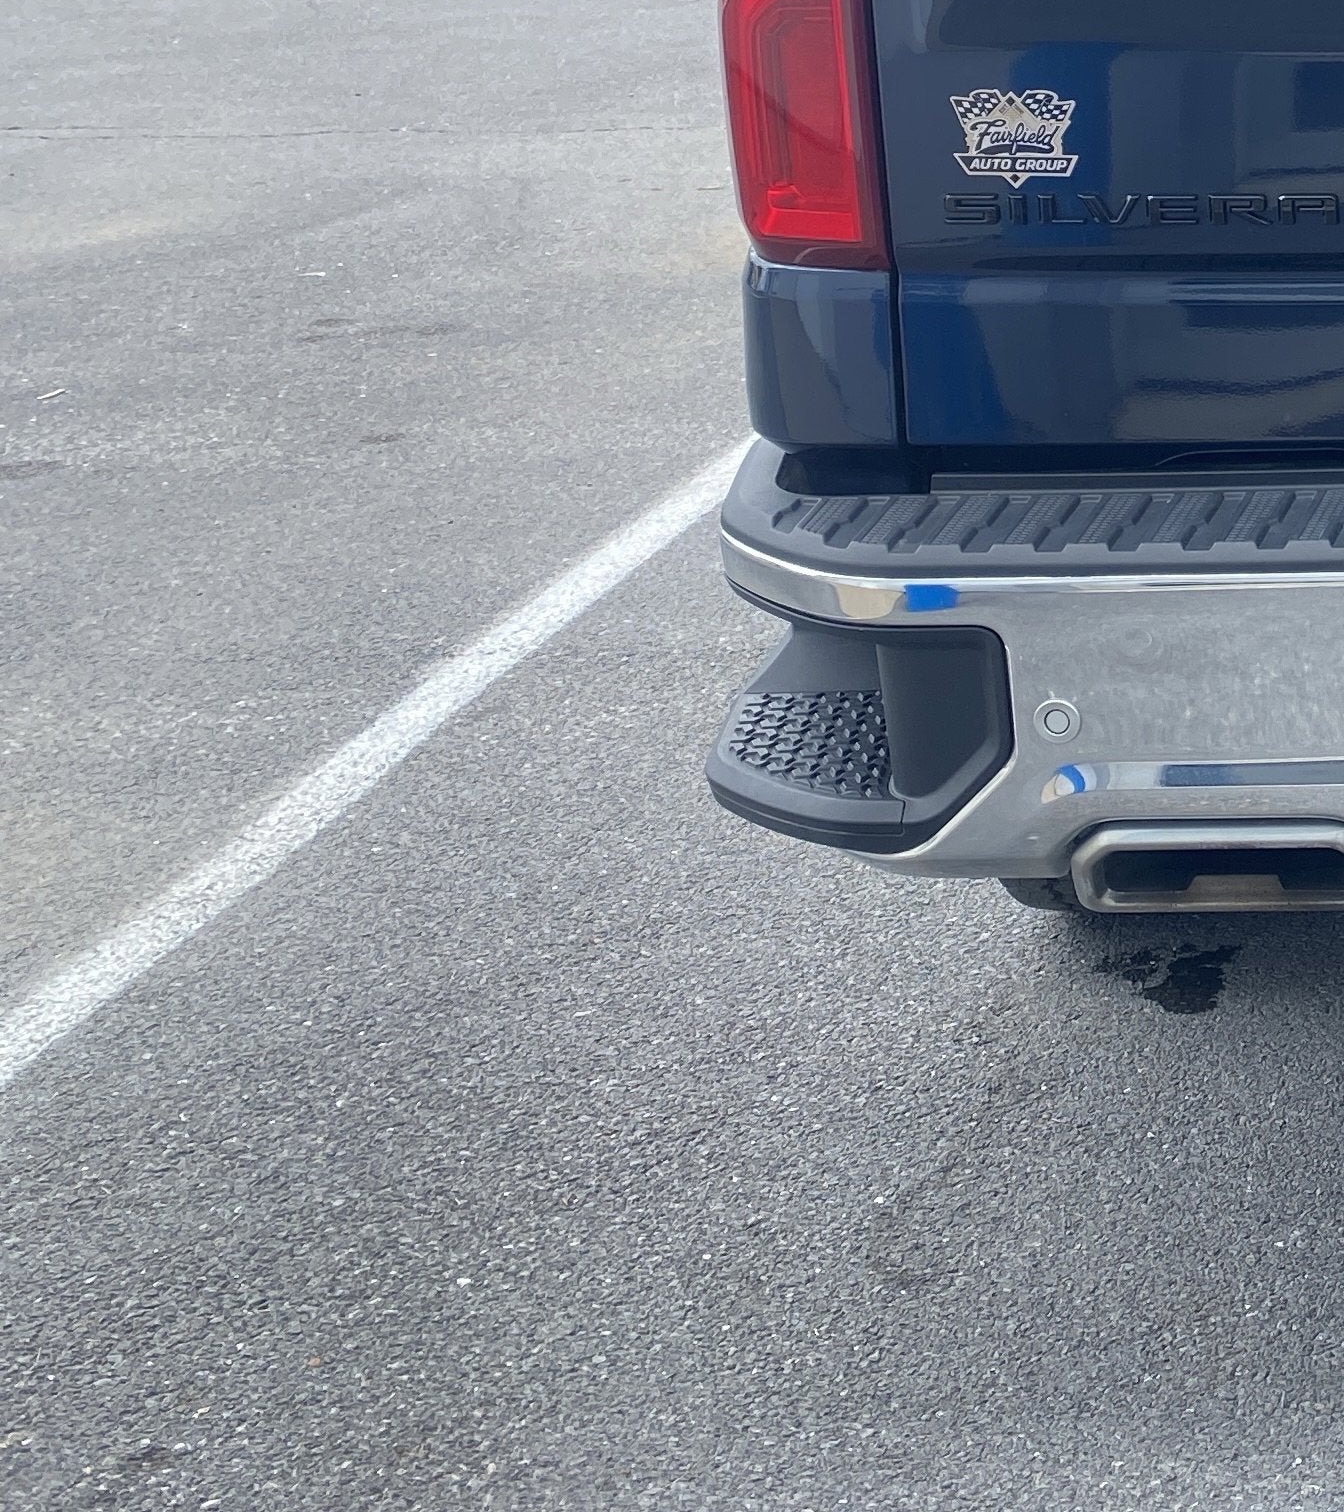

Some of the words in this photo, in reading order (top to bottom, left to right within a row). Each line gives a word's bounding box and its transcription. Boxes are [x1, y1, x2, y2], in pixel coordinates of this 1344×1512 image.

[969, 118, 1061, 155] Fairfield
[969, 158, 1012, 171] AUTO
[1014, 159, 1068, 171] GROUP
